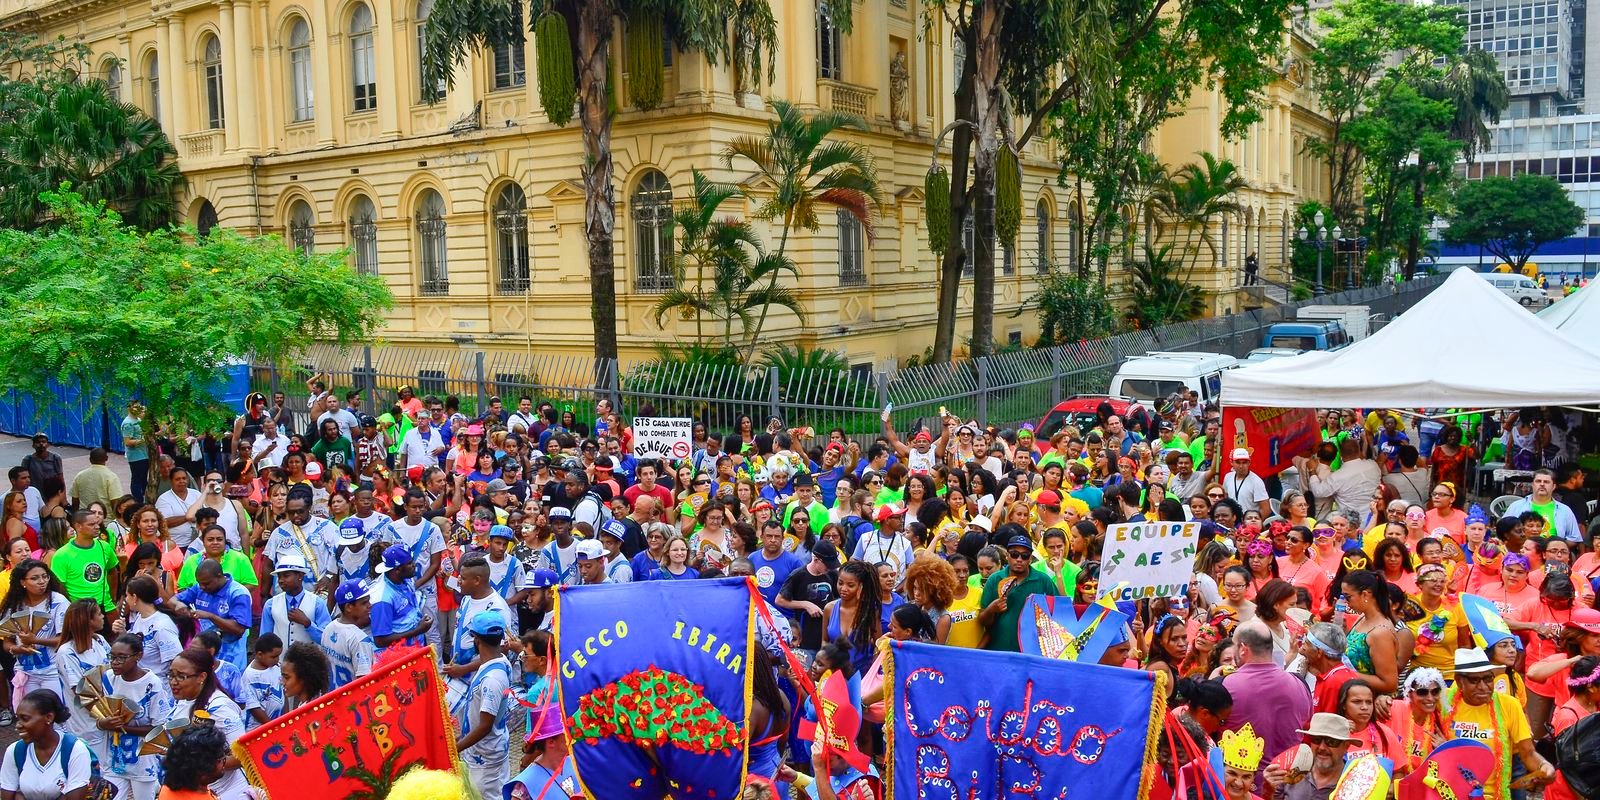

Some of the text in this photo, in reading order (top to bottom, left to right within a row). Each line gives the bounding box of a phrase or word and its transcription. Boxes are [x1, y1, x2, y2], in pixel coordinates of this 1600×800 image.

[635, 418, 650, 427] STS
[671, 420, 691, 428] VERDE
[634, 440, 672, 457] DENGUE
[1115, 523, 1195, 542] EQUIPE
[1134, 551, 1163, 567] AE
[1100, 583, 1188, 602] UCURUVI
[955, 611, 973, 622] Zika
[561, 620, 742, 679] CECCO IBIRA
[903, 667, 1123, 765] Cordão
[1461, 726, 1488, 739] Zika
